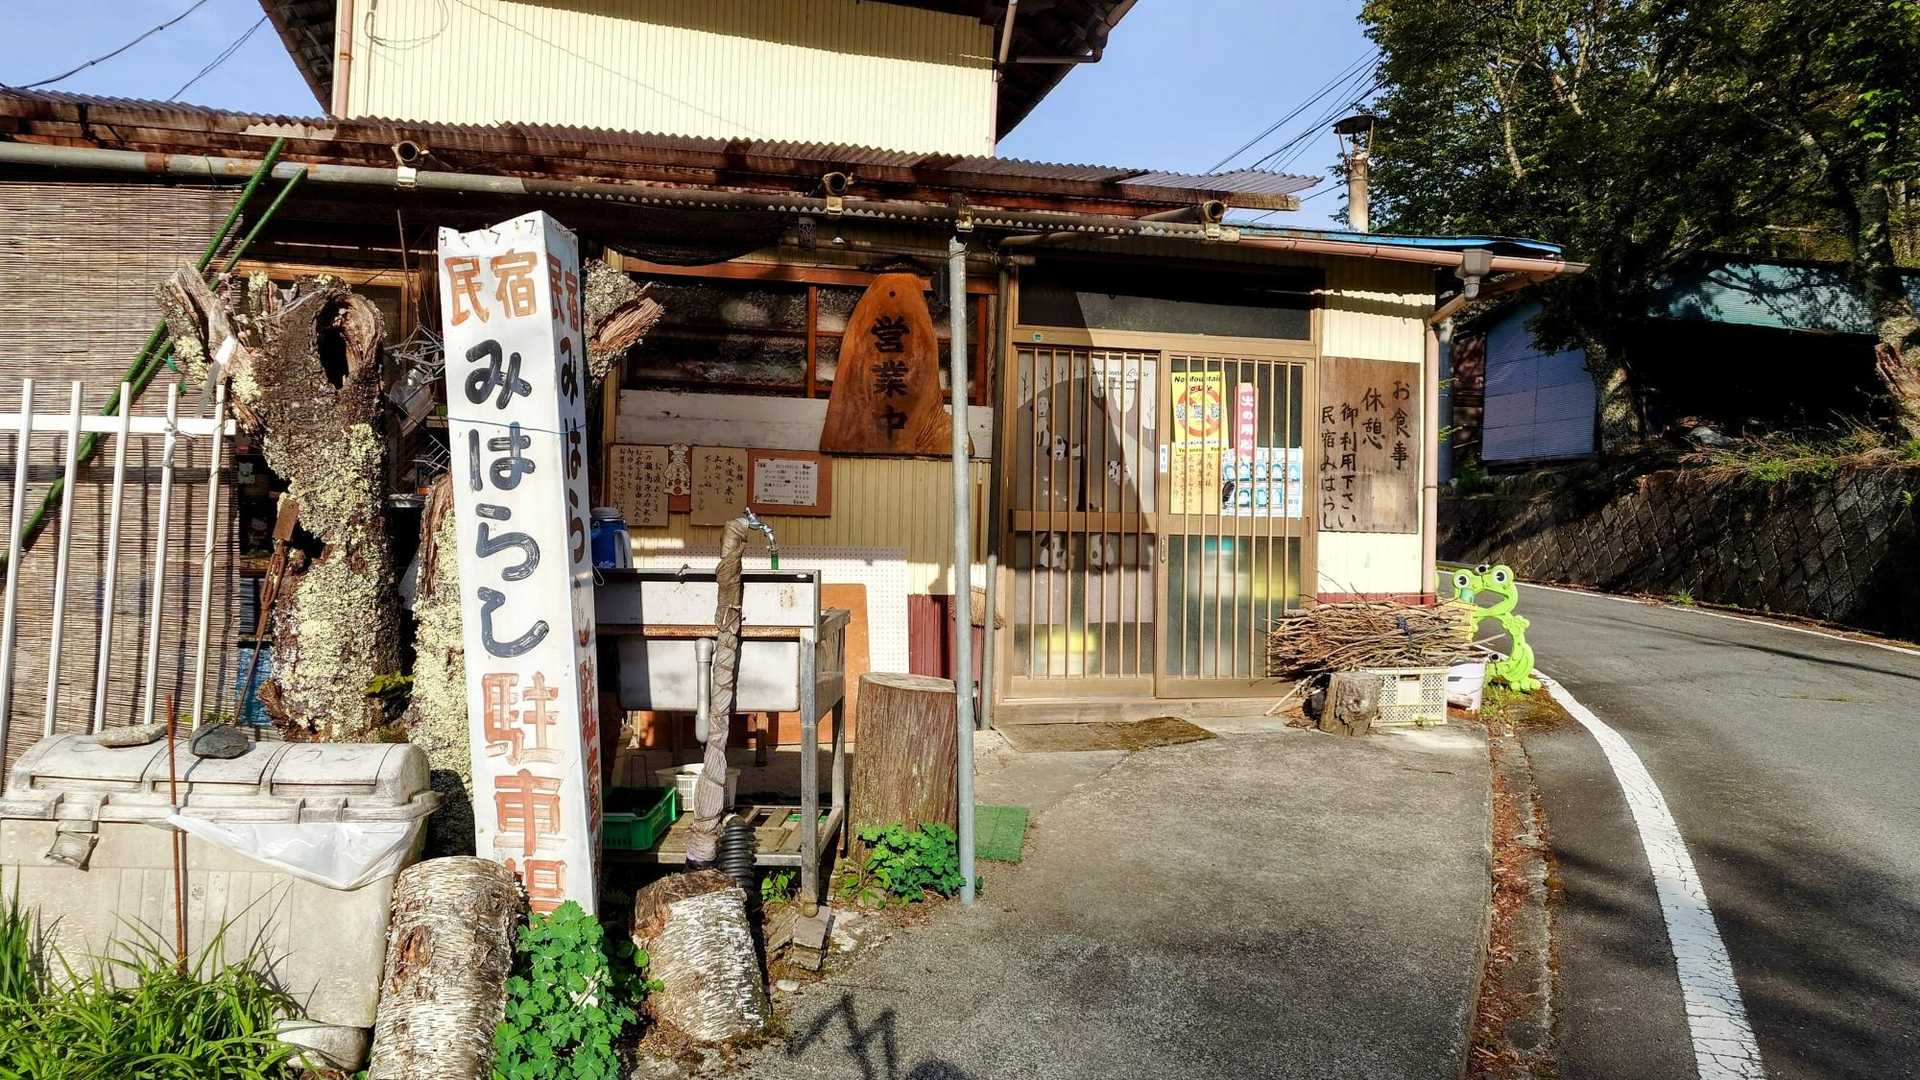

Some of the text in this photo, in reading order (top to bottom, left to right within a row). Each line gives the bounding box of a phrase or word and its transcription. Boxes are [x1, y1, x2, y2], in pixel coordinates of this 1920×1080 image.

[443, 249, 538, 326] 民宿
[547, 253, 579, 332] 民宿
[870, 315, 910, 440] 営業中
[1361, 387, 1386, 450] 休憩
[1391, 380, 1411, 471] お食事
[464, 339, 549, 659] みはらし
[1320, 406, 1337, 530] 民宿みはらし
[1337, 402, 1359, 528] 御利用下さい
